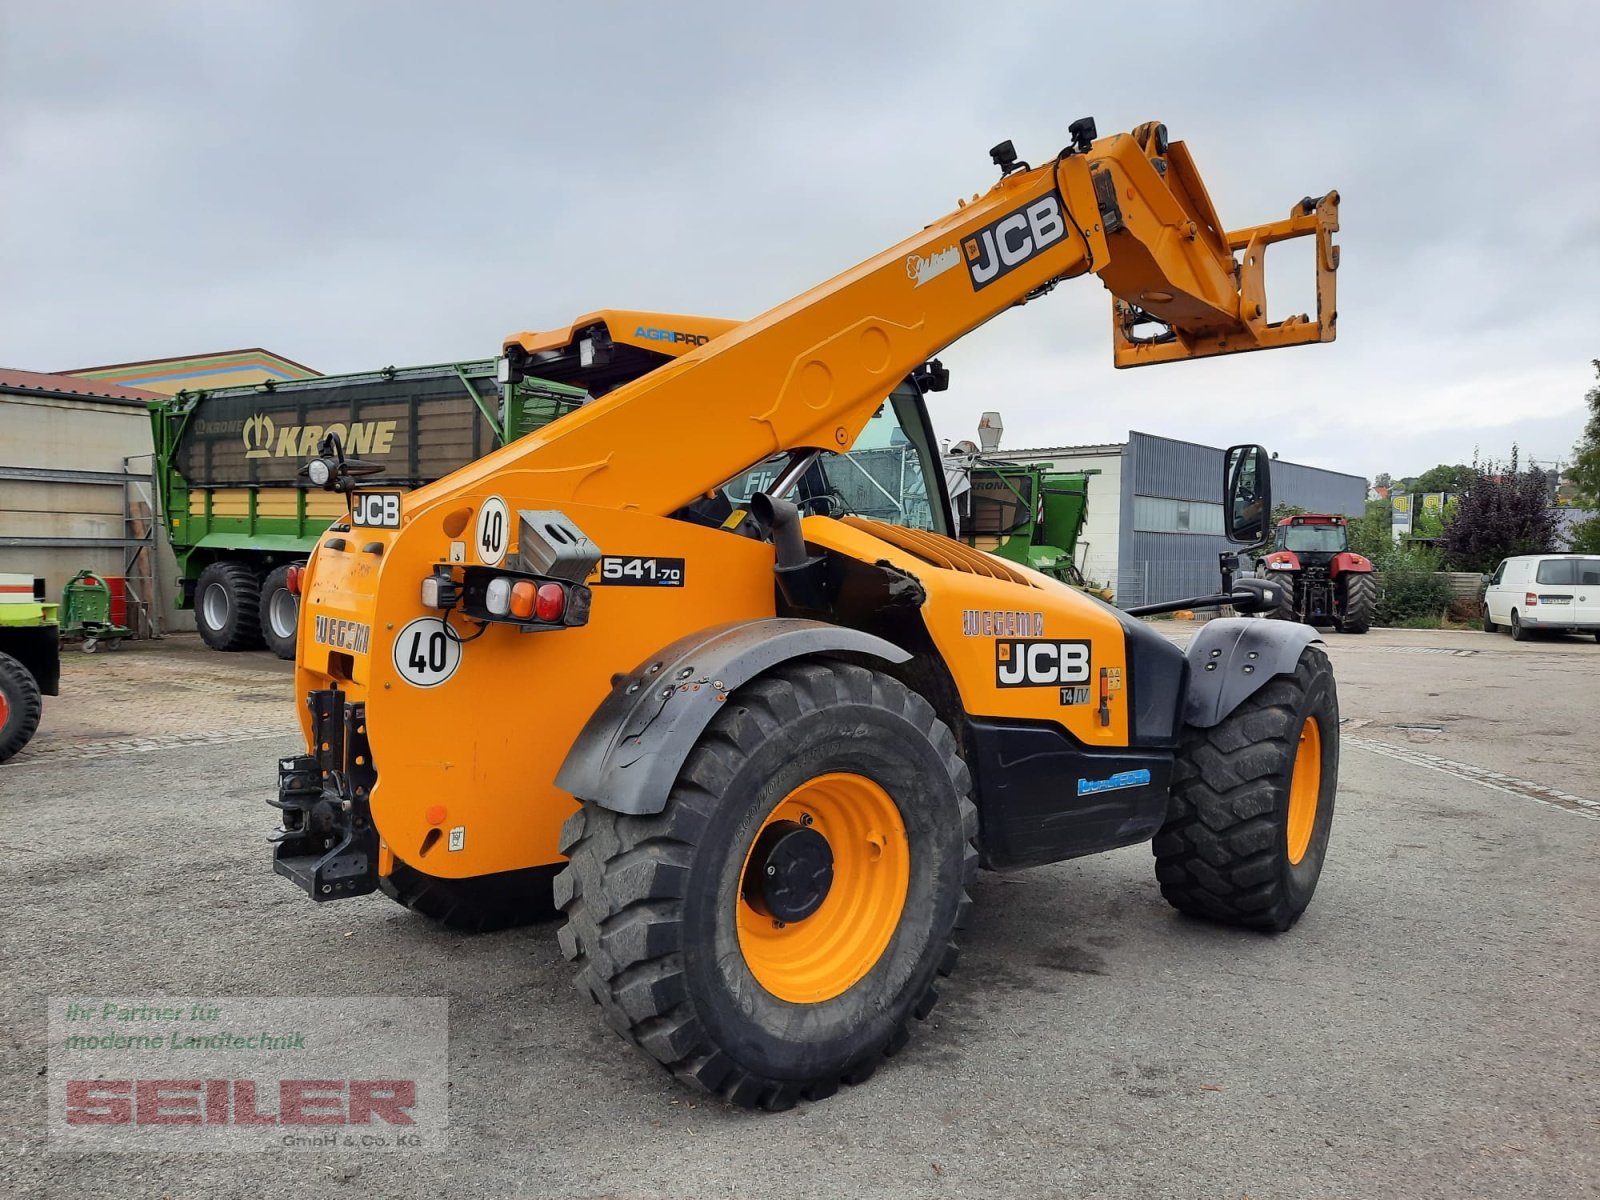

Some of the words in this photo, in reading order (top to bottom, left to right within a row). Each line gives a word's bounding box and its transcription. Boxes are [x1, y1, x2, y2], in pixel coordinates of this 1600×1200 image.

[972, 196, 1065, 284] JCB
[634, 326, 710, 346] AGRIPRO
[205, 420, 243, 433] KRONE
[275, 420, 397, 457] KRONE
[353, 495, 399, 526] JCB
[482, 510, 501, 552] 40
[602, 558, 680, 580] 541-70
[315, 615, 371, 654] WEGEMA
[963, 610, 1044, 636] WEGEMA
[408, 631, 447, 674] 40
[998, 643, 1090, 684] JCB
